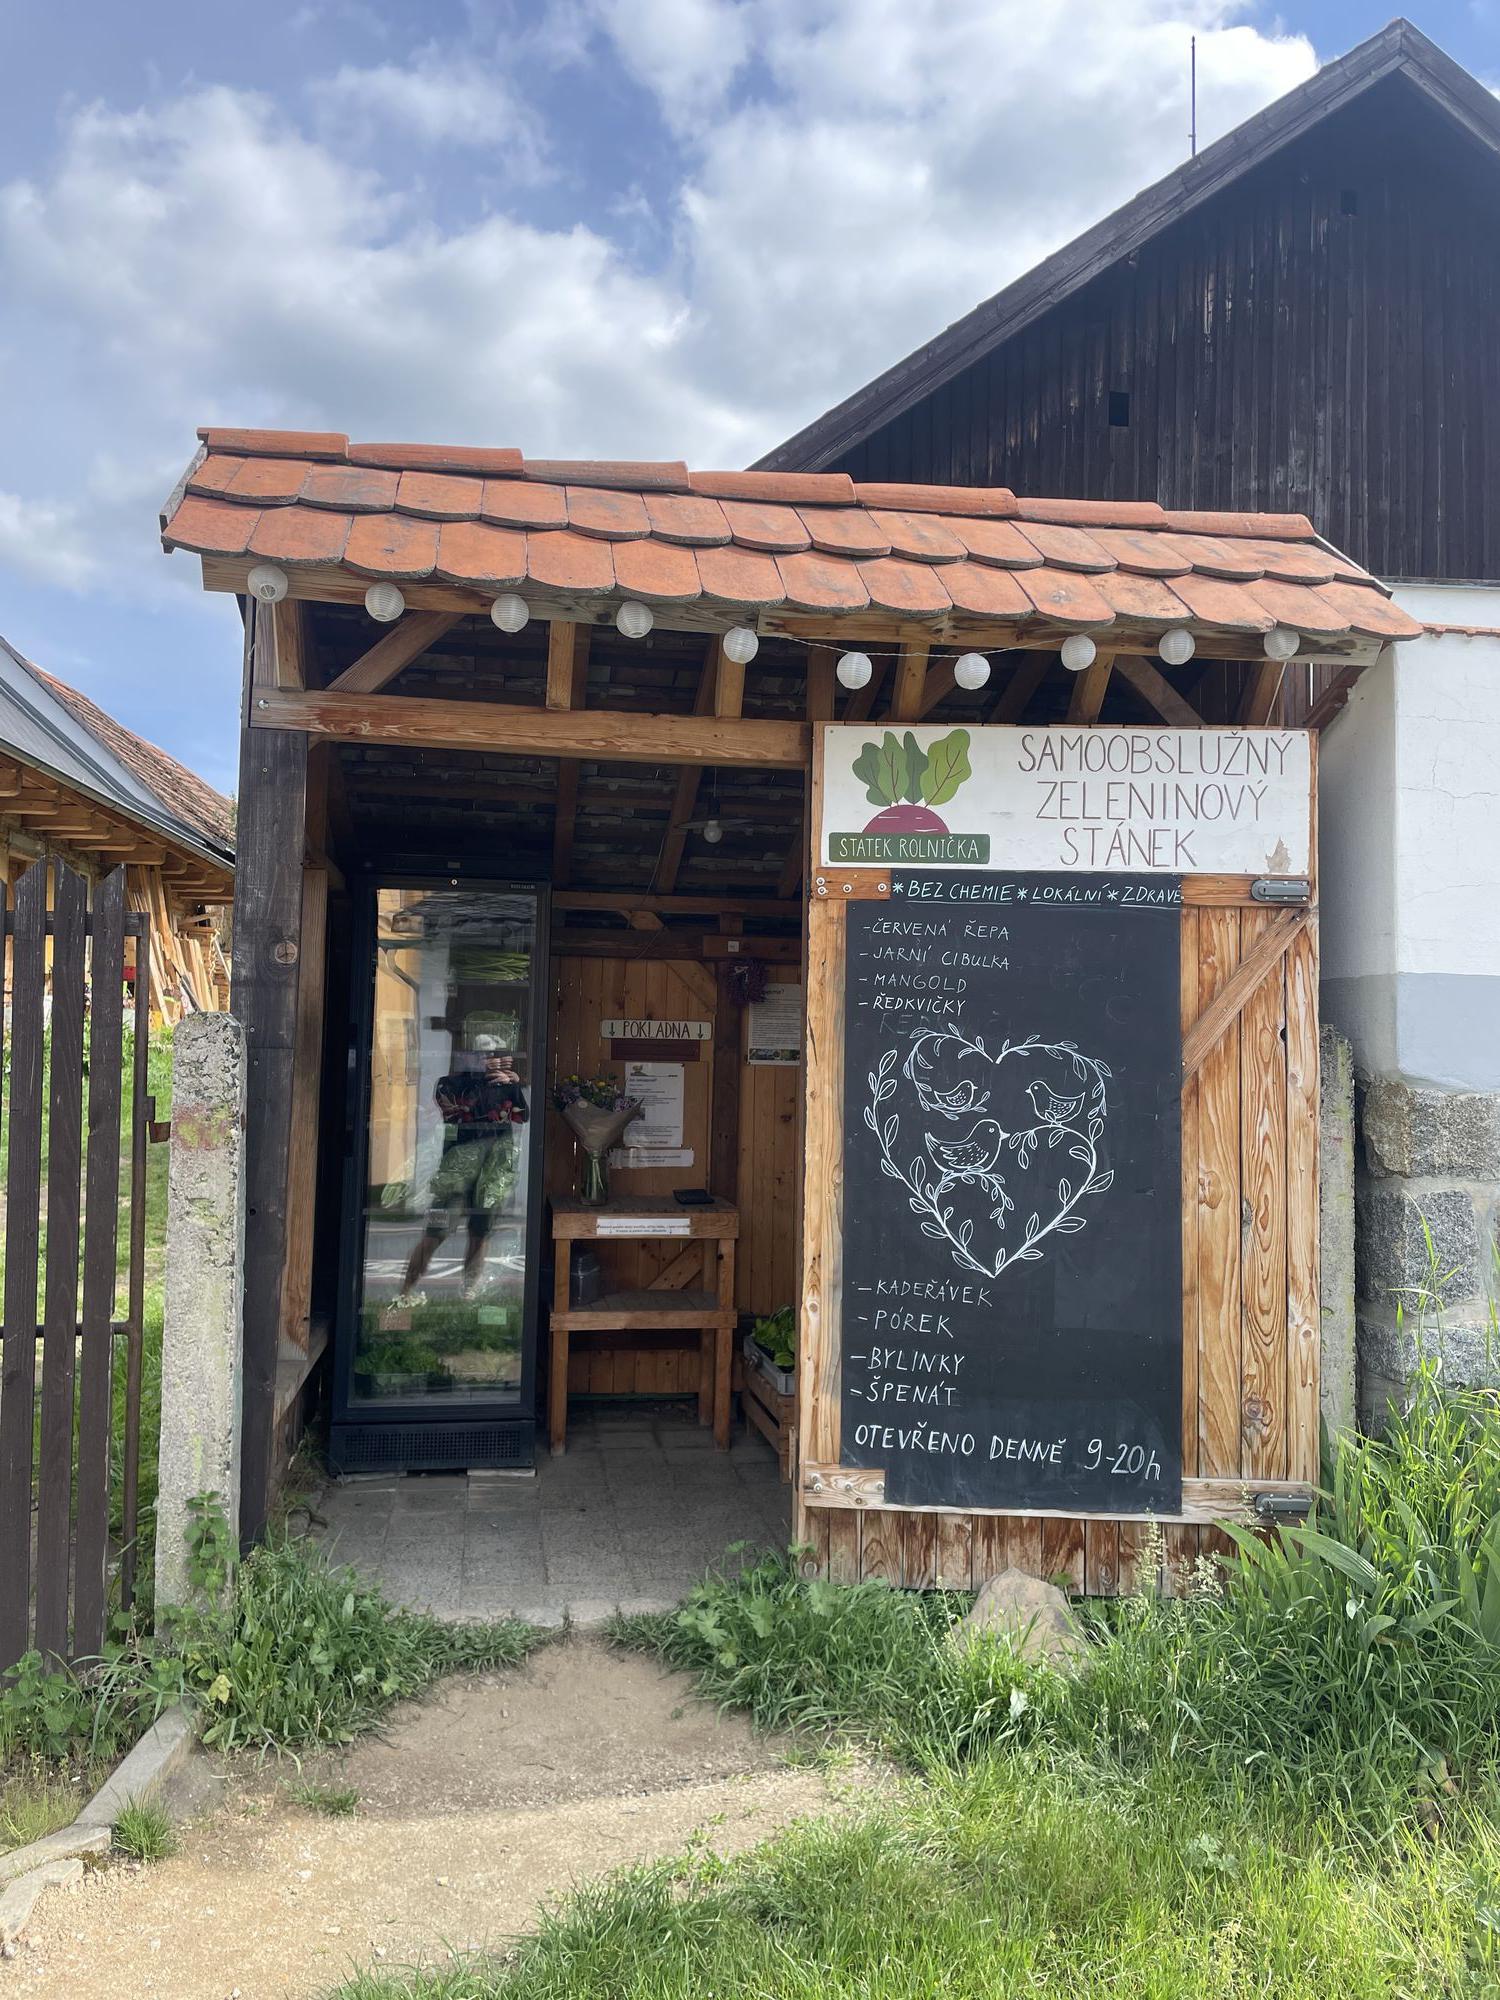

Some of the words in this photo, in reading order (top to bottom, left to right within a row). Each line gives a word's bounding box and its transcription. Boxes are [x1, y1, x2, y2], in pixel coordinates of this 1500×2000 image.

[1018, 731, 1294, 777] SAMOOBSLUŽNÝ
[1036, 780, 1269, 822] ZELENINOVÝ
[839, 837, 892, 859] STATEK
[899, 836, 980, 860] ROLNIČKA
[1060, 822, 1198, 868] STÁNEK
[907, 880, 943, 898] BEZ
[949, 883, 1015, 902] CHEMIE
[1031, 883, 1110, 903] LOKÁLNÍ
[872, 917, 952, 937] ČERVENÁ
[963, 919, 1009, 941] ŘEPA
[873, 944, 932, 963] JARNÍ
[941, 950, 1010, 970] CIBULKA
[873, 972, 968, 994] MANGOLD
[872, 992, 966, 1017] ŘEDKVIČKY
[622, 1021, 691, 1039] POKLADNA
[875, 1278, 993, 1307] KADEŘÁVEK
[874, 1306, 954, 1338] PÓREK
[867, 1346, 965, 1376] BYLINKY
[866, 1375, 957, 1406] ŠPENÁT
[854, 1421, 976, 1455] OTEVŘENO
[989, 1434, 1067, 1464] DENNĚ
